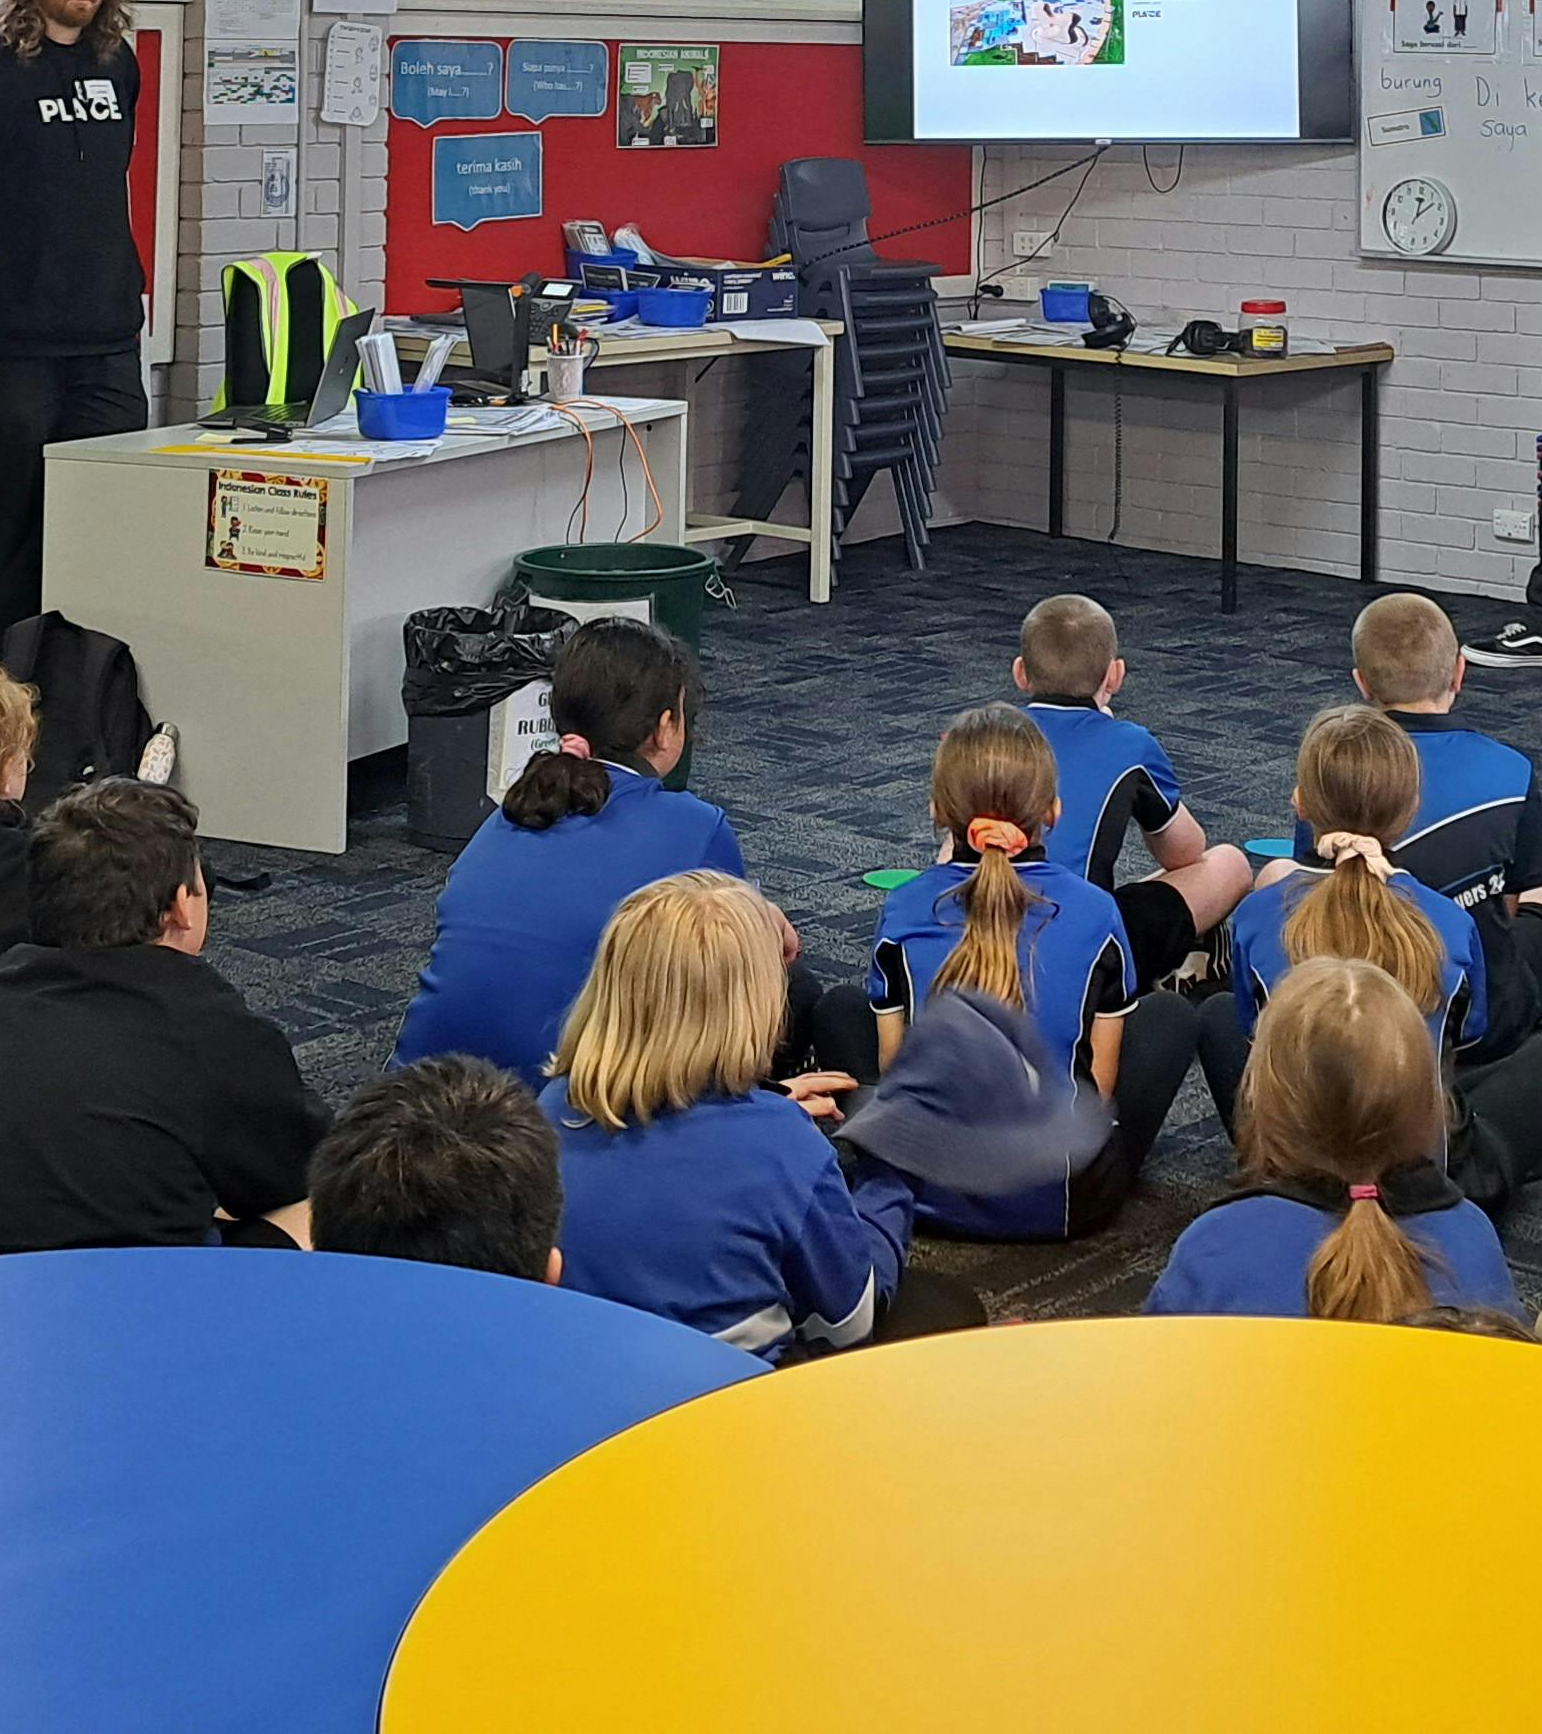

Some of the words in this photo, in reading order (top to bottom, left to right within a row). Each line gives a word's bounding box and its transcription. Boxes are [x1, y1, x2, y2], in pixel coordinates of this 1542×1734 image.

[400, 61, 434, 75] Boleh
[1380, 67, 1443, 99] burung
[1475, 75, 1500, 108] Di
[456, 159, 492, 174] terima
[494, 157, 522, 172] kasih
[218, 481, 266, 496] Indonesian
[268, 486, 291, 498] Class
[293, 488, 317, 500] Rules
